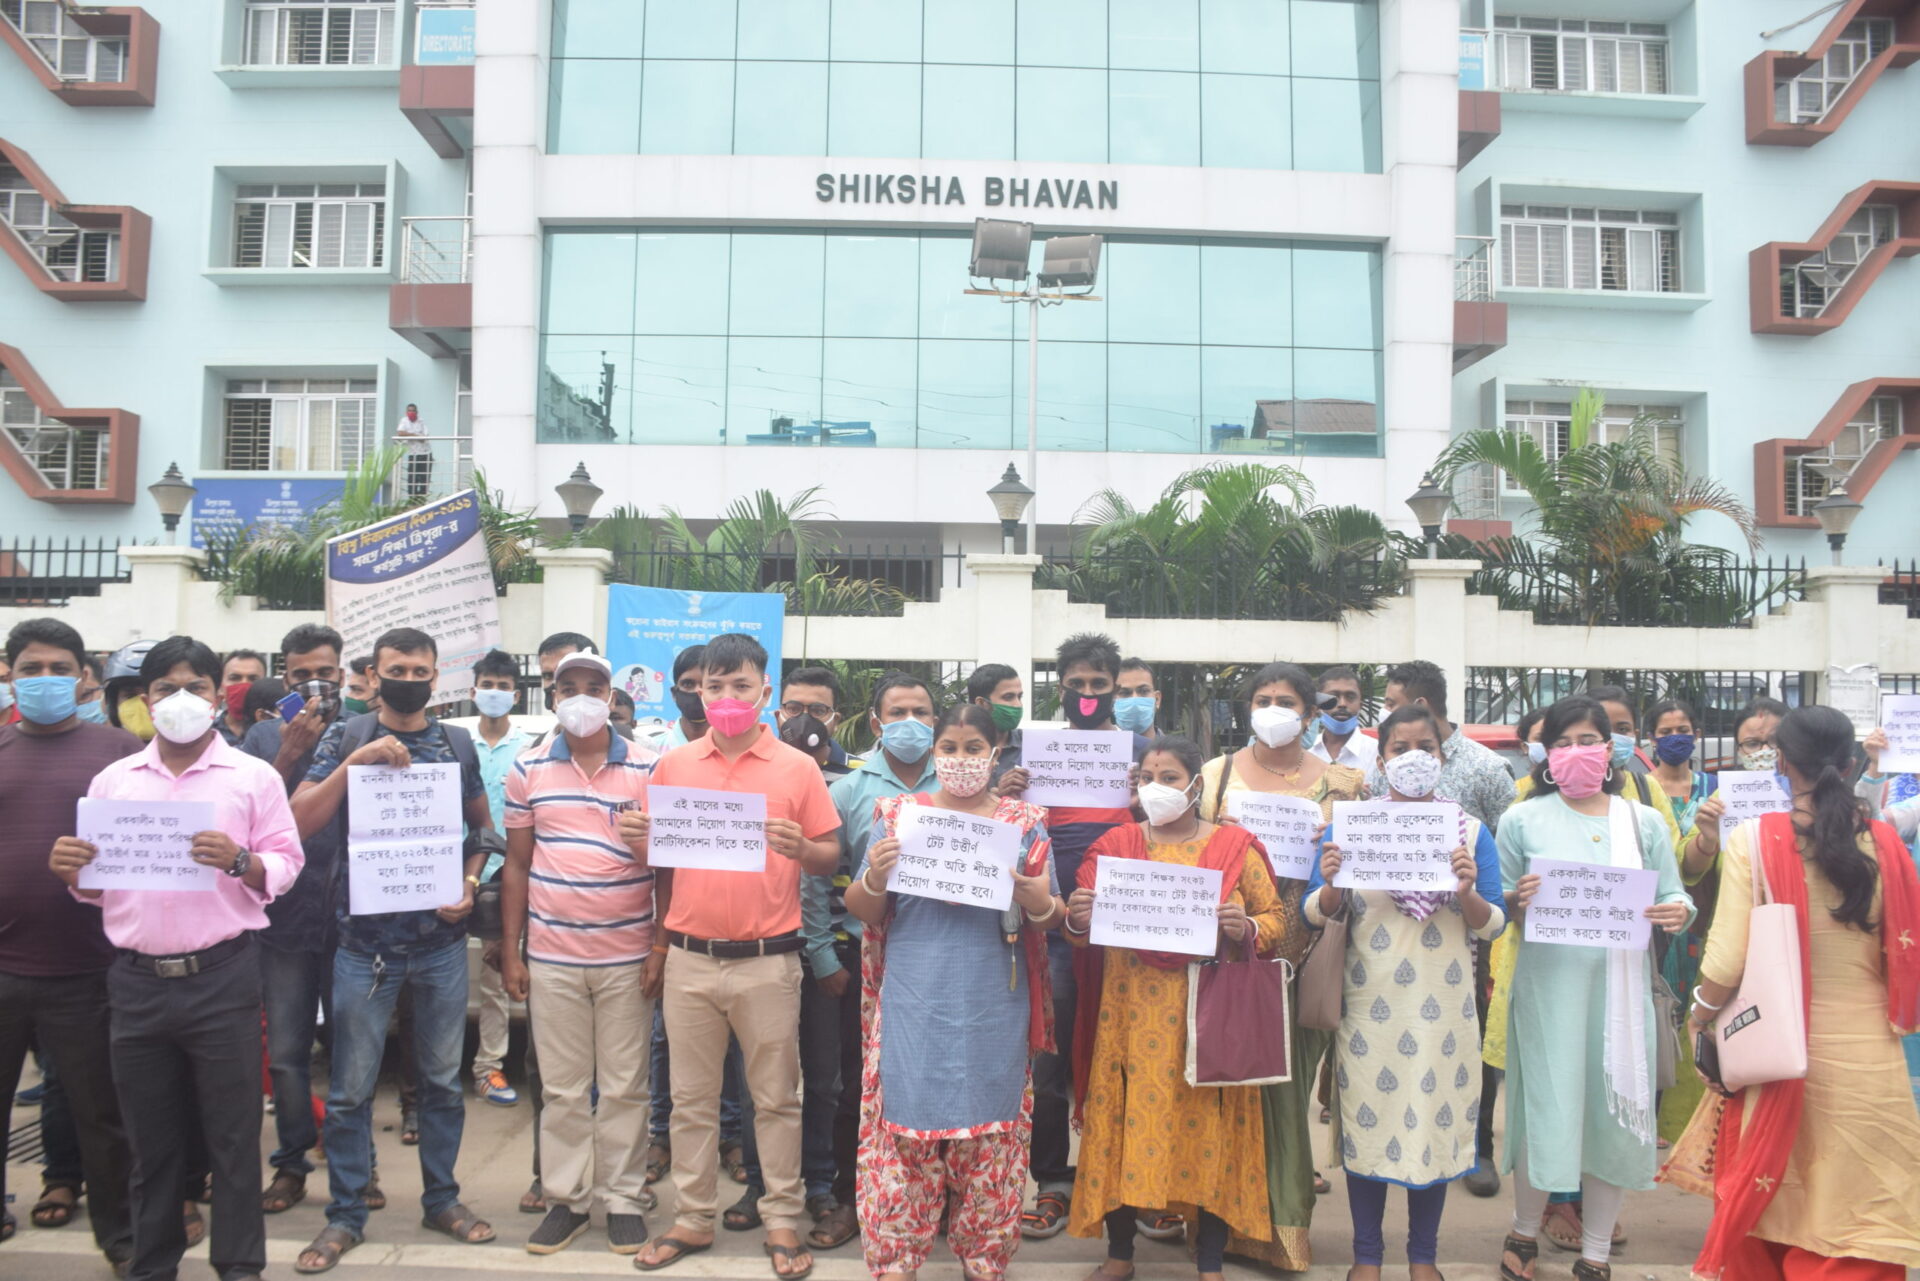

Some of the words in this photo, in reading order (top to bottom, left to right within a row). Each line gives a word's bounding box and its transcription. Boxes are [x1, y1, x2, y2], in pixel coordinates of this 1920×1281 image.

[816, 173, 965, 205] SHIKSHA
[985, 177, 1118, 209] BHAVAN
[381, 538, 407, 556] শিক্ষা
[1046, 742, 1060, 752] এই
[1065, 743, 1088, 753] মাসের
[1094, 744, 1111, 753] মধ্যে
[1028, 760, 1062, 771] আমাদের
[1068, 758, 1094, 771] নিয়োগ
[1099, 761, 1128, 771] সংক্রান্ত
[1085, 776, 1104, 788] দিতে
[1109, 779, 1128, 789] হবে।
[673, 798, 687, 810] এই
[693, 800, 718, 811] মাসের
[724, 802, 743, 812] মধ্যে
[654, 818, 692, 828] আমাদের
[697, 816, 725, 830] নিয়োগ
[731, 820, 763, 831] সংক্রান্ত
[917, 815, 965, 831] এককালীন
[972, 822, 994, 836] ছাড়ে
[1347, 812, 1388, 825] কোয়ালিটি
[1394, 815, 1444, 827] এডুকেশনের
[371, 829, 394, 837] সকল
[400, 826, 445, 837] বেকারদের
[1347, 834, 1362, 843] মান
[1368, 834, 1391, 843] বজায়
[1397, 834, 1421, 843] রাখার
[1426, 834, 1444, 843] জন্য
[654, 834, 710, 847] নোটিফিকেশন
[716, 836, 737, 849] দিতে
[743, 840, 763, 850] হবে।
[927, 834, 945, 848] টেট
[951, 838, 980, 854] উত্তীর্ণ
[1340, 850, 1352, 861] টট
[1358, 849, 1398, 862] উত্তীর্ণদের
[1404, 850, 1427, 862] অতি
[405, 864, 434, 876] নিয়োগ
[900, 854, 938, 868] সকলকে
[944, 859, 967, 873] অতি
[974, 861, 999, 879] শীঘ্রই
[1151, 872, 1175, 882] শিক্ষক
[1181, 876, 1205, 885] সংকট
[1353, 867, 1381, 880] নিয়োগ
[1386, 871, 1413, 882] করতে
[1418, 872, 1438, 882] হবে।
[1548, 867, 1596, 880] এককালীন
[1604, 872, 1627, 884] ছাড়ে
[382, 885, 408, 895] করতে
[898, 871, 929, 888] নিয়োগ
[936, 880, 965, 894] করতে
[971, 886, 993, 899] হবে।
[1560, 885, 1577, 899] টেট
[1584, 886, 1612, 900] উত্তীর্ণ
[1150, 890, 1167, 899] জন্য
[1172, 888, 1187, 899] টেট
[1192, 890, 1215, 901] উত্তীর্ণ
[1097, 902, 1117, 911] সকল
[1168, 904, 1186, 915] অতি
[1535, 906, 1572, 918] সকলকে
[1579, 906, 1602, 919] অতি
[1608, 907, 1634, 922] শীঘ্রই
[1113, 921, 1140, 933] নিয়োগ
[1145, 925, 1169, 935] করতে
[1175, 927, 1194, 936] হবে।
[1535, 923, 1566, 938] নিয়োগ
[1573, 928, 1602, 939] করতে
[1608, 930, 1631, 941] হবে।
